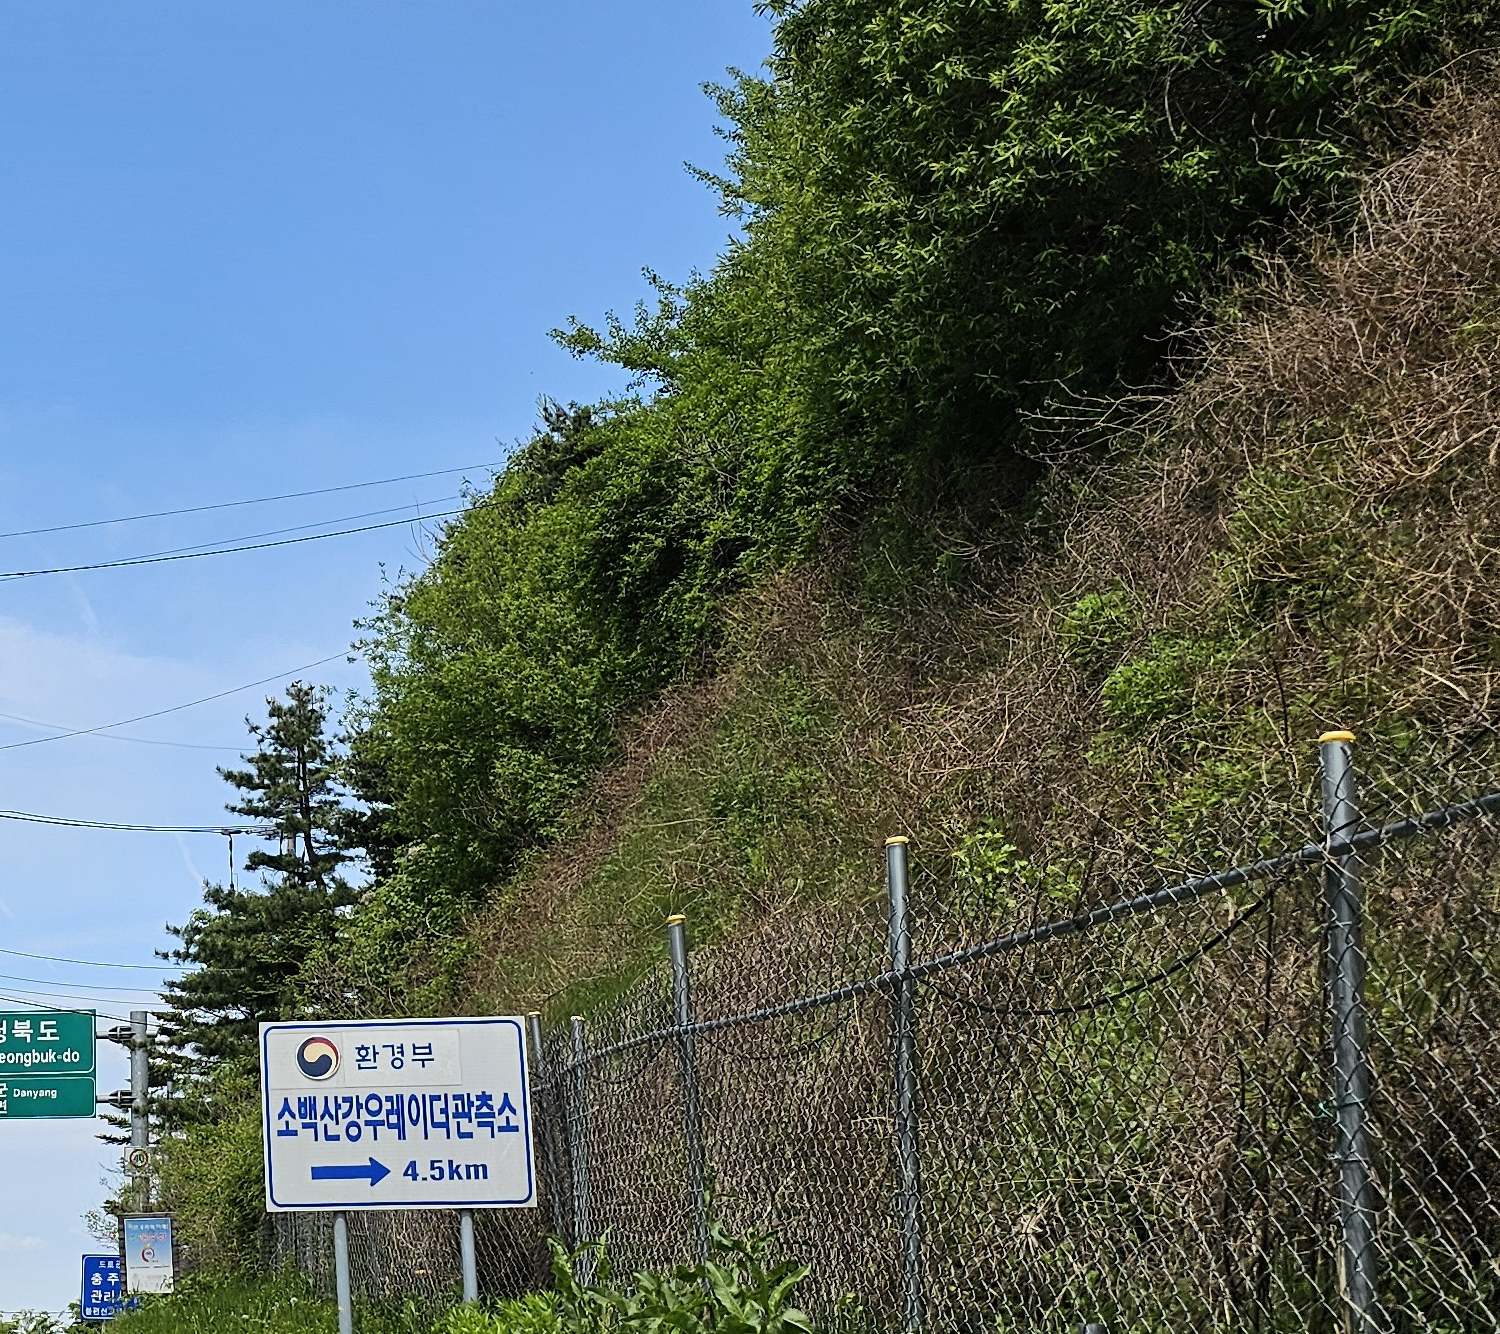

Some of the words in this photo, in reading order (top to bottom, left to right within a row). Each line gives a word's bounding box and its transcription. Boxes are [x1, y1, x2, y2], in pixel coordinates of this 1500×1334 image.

[354, 1042, 435, 1070] 환경부
[13, 1088, 58, 1099] Danyang
[276, 1091, 520, 1142] 소백산강우레이더관측소
[402, 1159, 489, 1182] 4.5km
